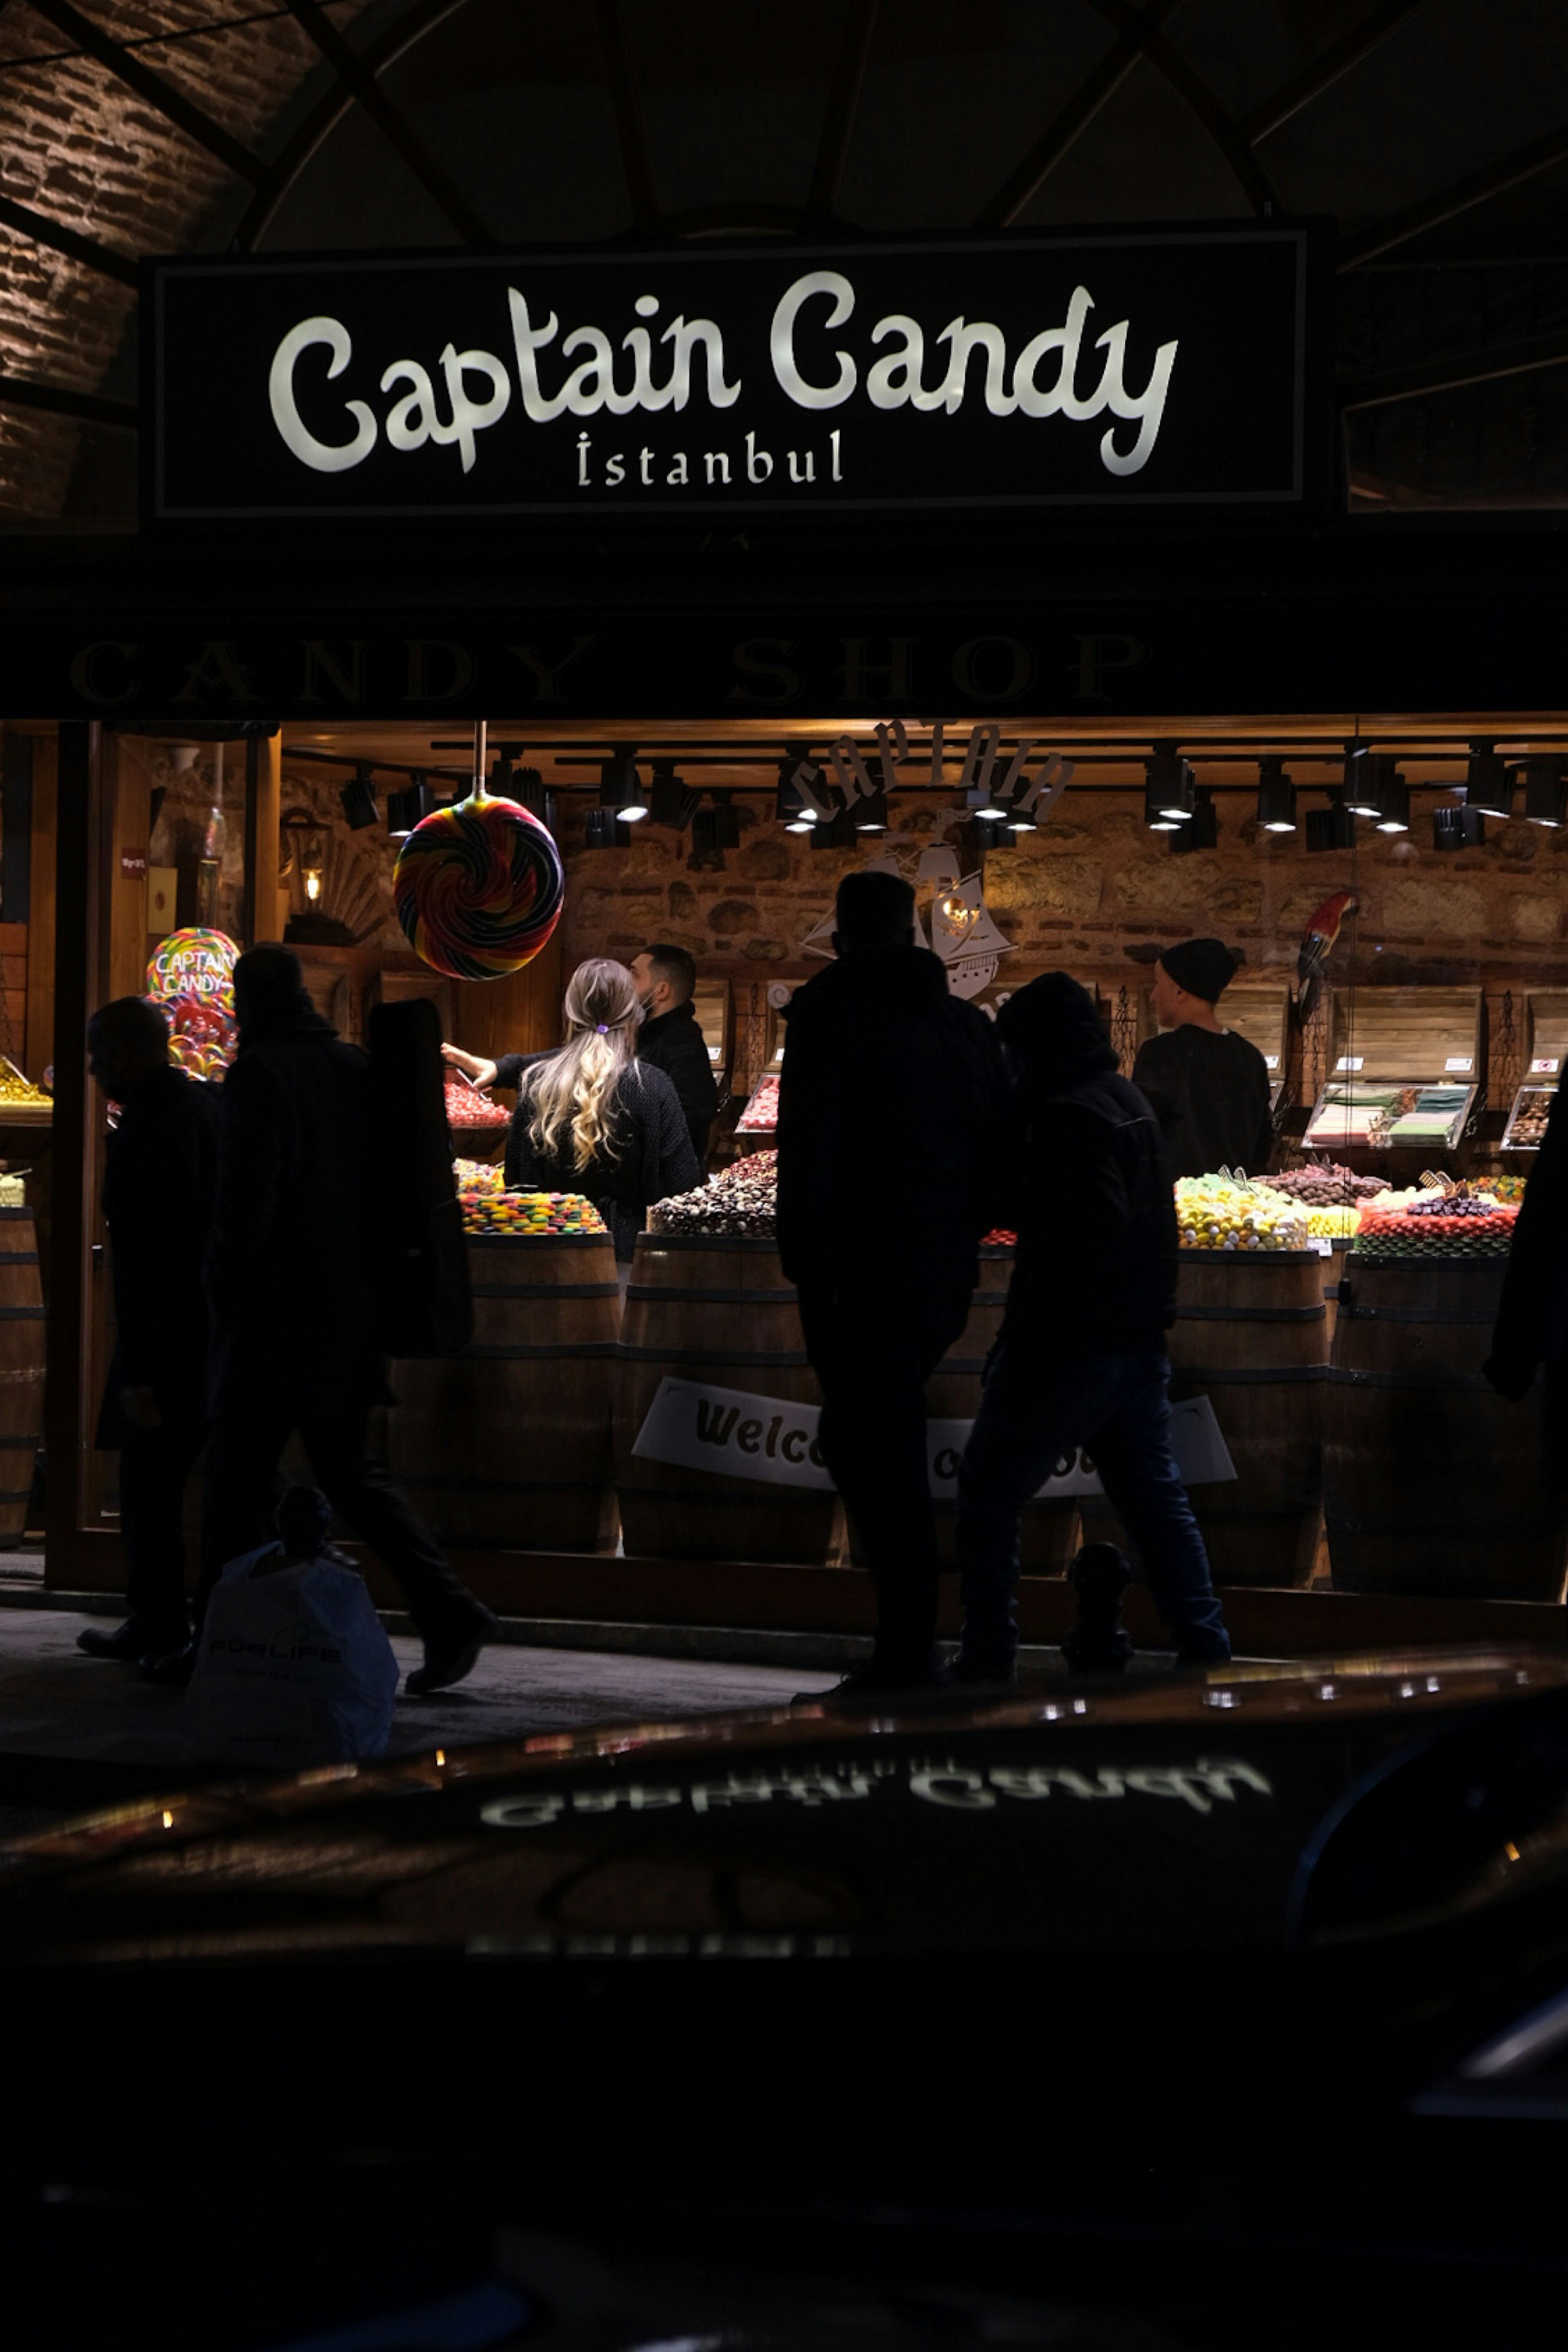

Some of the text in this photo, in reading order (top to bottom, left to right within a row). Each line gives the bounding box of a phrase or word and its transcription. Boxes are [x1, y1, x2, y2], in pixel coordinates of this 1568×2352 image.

[269, 271, 1179, 475] Captain Candy
[576, 430, 843, 485] İstanbul
[67, 631, 1153, 705] CANDY SHOP
[156, 951, 238, 974] CAPTAIN
[163, 973, 225, 993] CANDY
[697, 1398, 828, 1467] Welco
